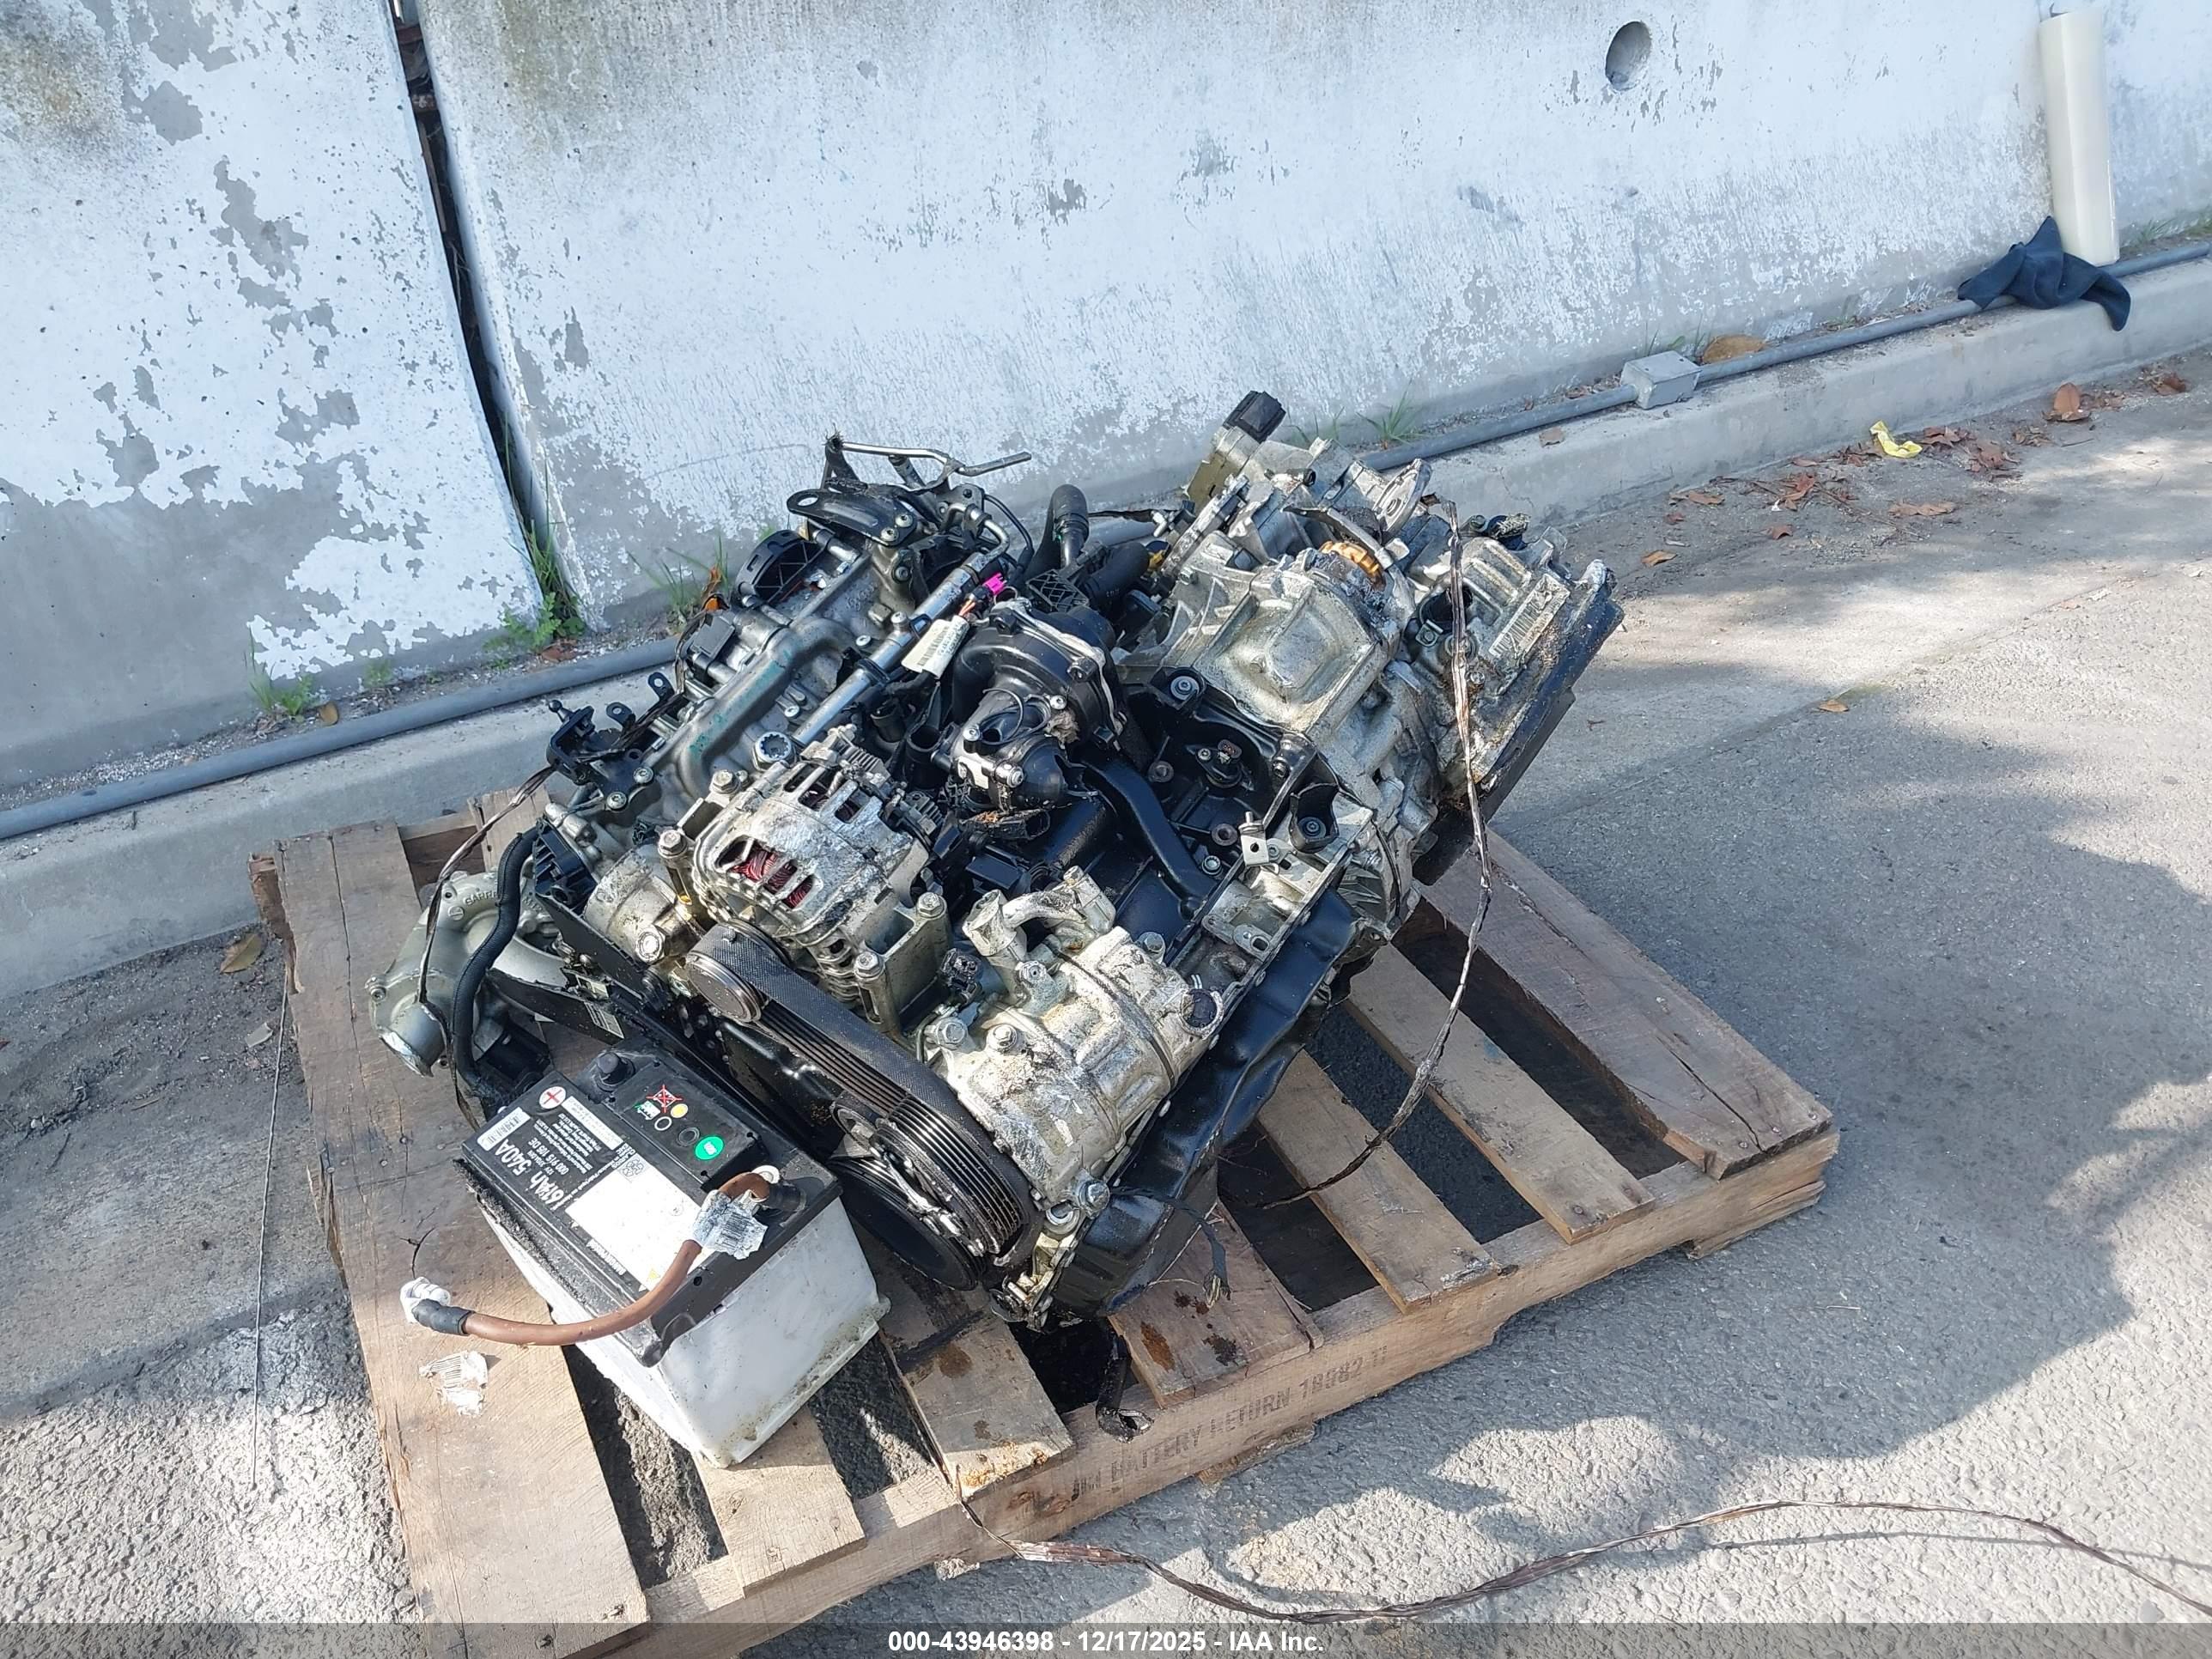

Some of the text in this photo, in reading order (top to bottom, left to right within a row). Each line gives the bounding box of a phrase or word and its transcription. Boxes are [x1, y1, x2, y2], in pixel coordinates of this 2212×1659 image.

[528, 1138, 541, 1149] DE
[495, 1139, 532, 1176] 540A
[545, 1154, 560, 1166] 915
[555, 1163, 569, 1176] 000
